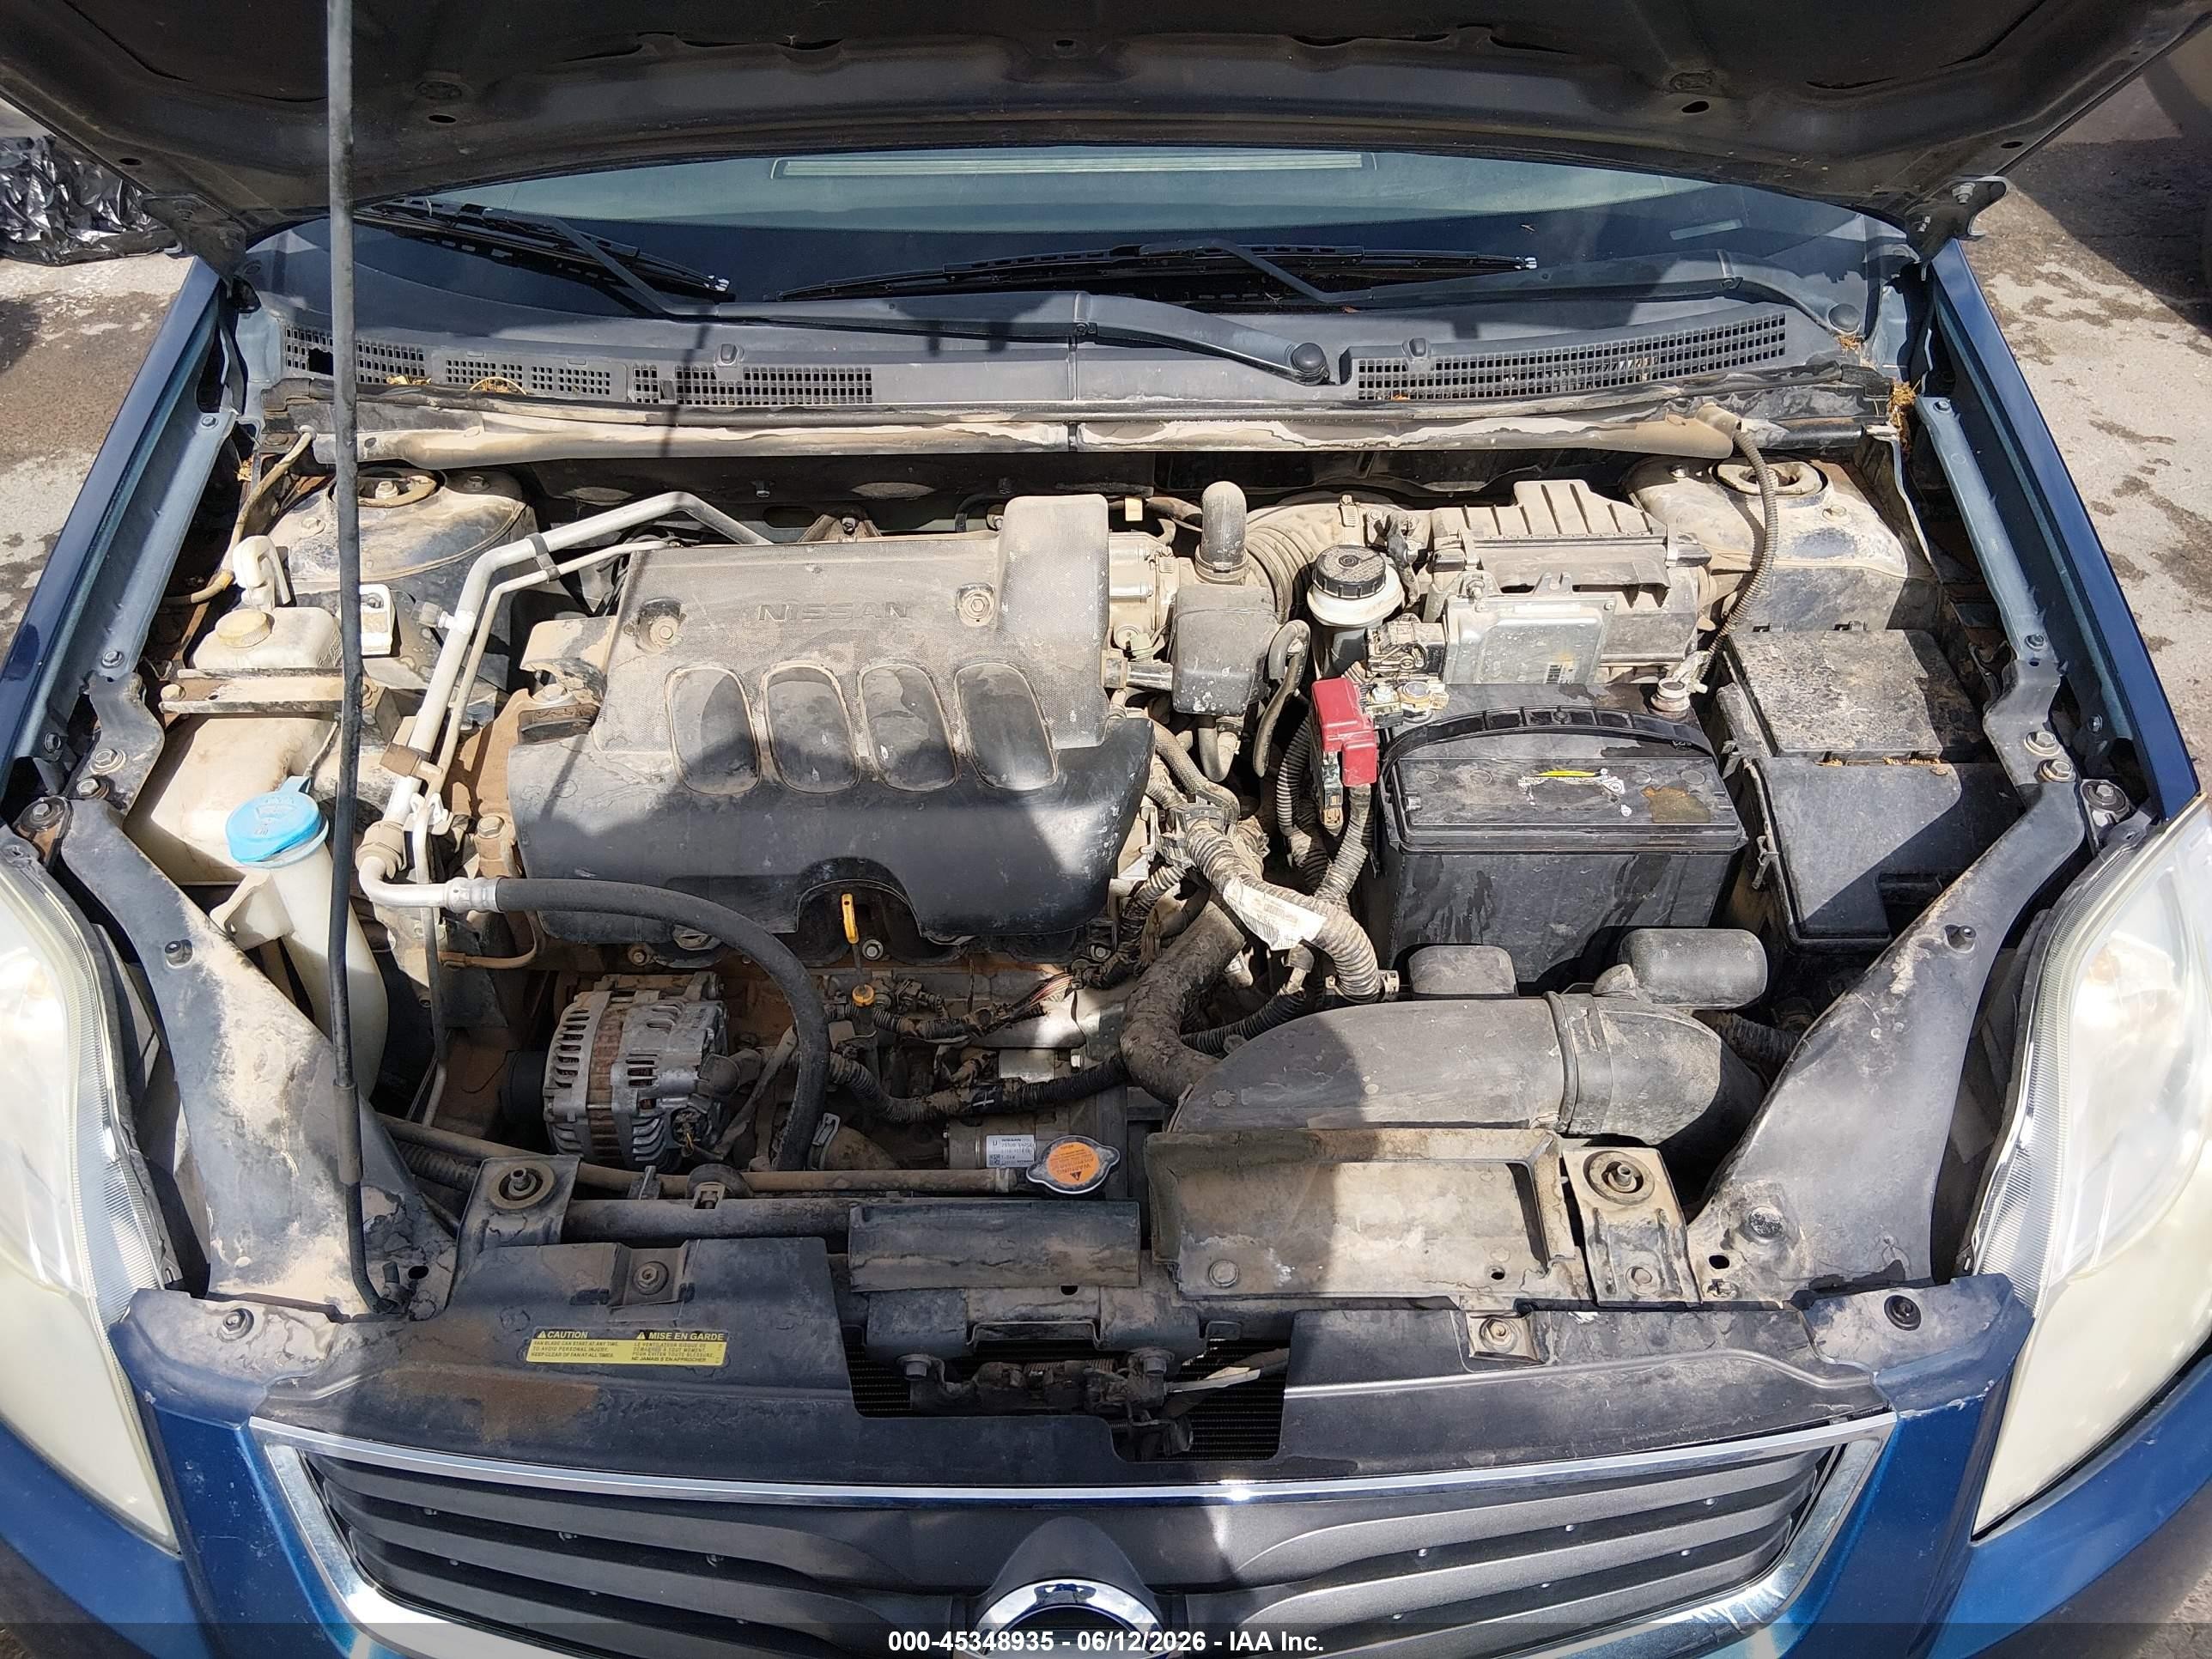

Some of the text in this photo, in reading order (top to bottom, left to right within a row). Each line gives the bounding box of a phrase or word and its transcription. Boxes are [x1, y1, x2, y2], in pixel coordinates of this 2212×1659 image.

[758, 601, 909, 622] NISSAN
[648, 1332, 672, 1340] MISE
[690, 1333, 725, 1341] GARDE
